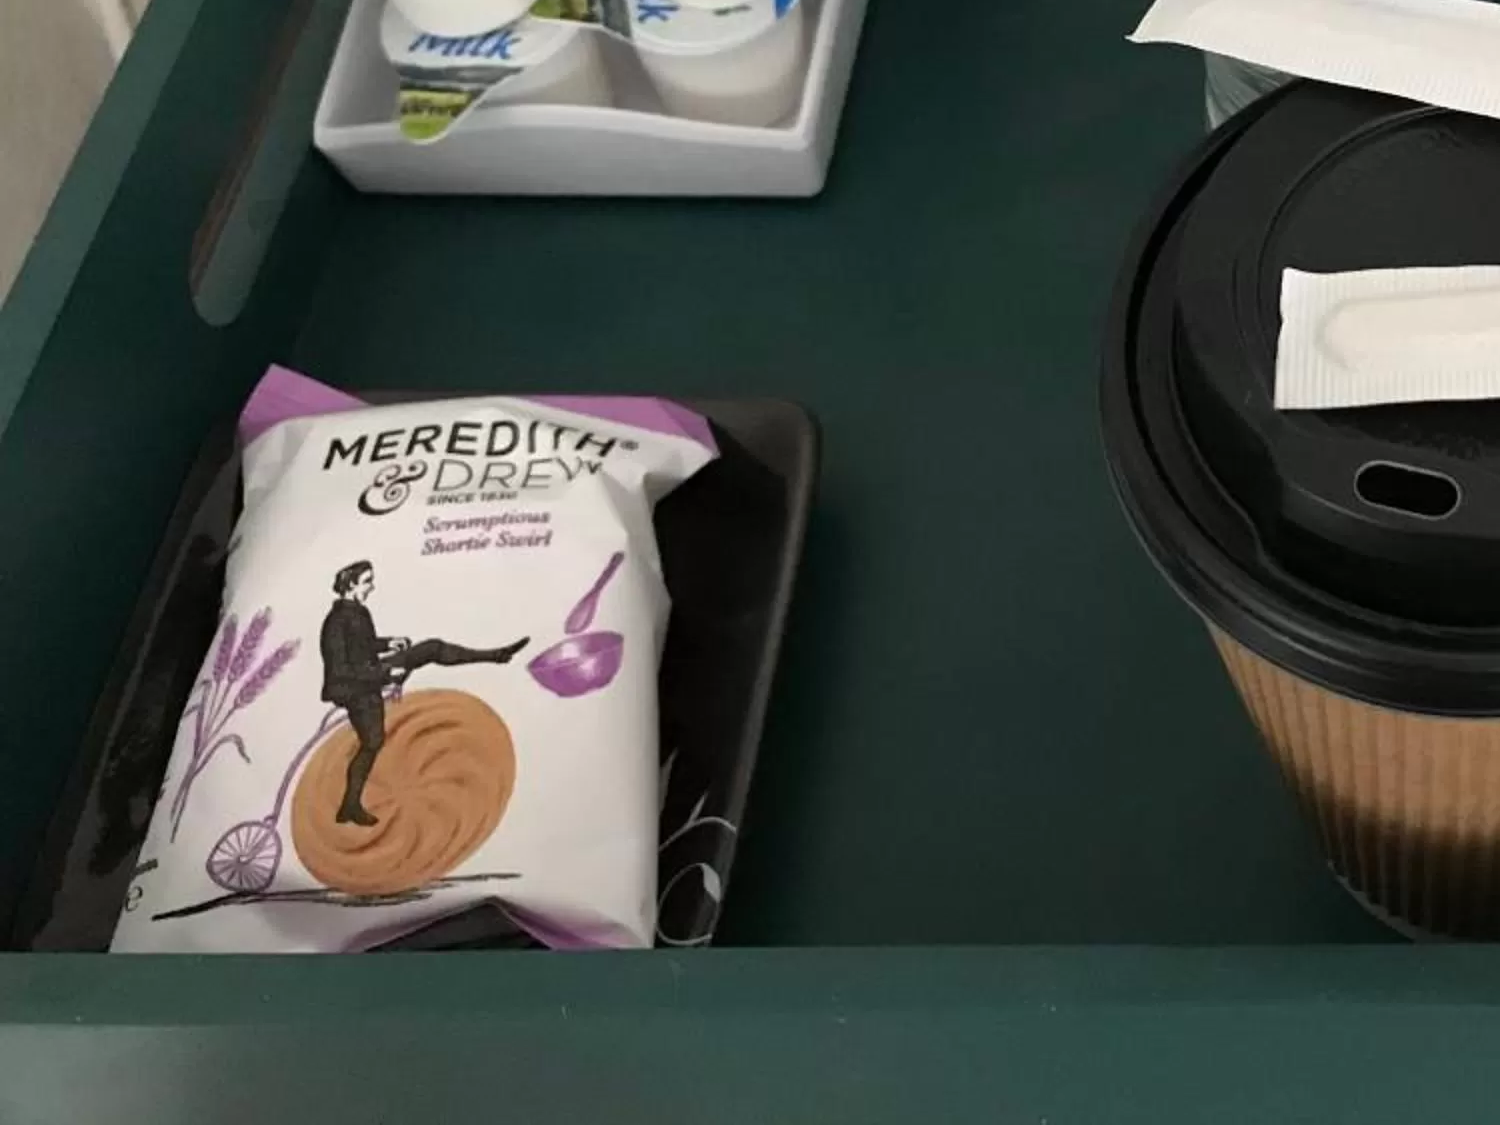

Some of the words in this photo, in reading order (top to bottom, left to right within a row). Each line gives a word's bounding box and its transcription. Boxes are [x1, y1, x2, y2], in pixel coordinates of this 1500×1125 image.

[323, 419, 618, 470] MEREDITH
[422, 511, 552, 534] Scrumptious
[420, 535, 492, 556] Shortie
[495, 528, 554, 548] Swirl
